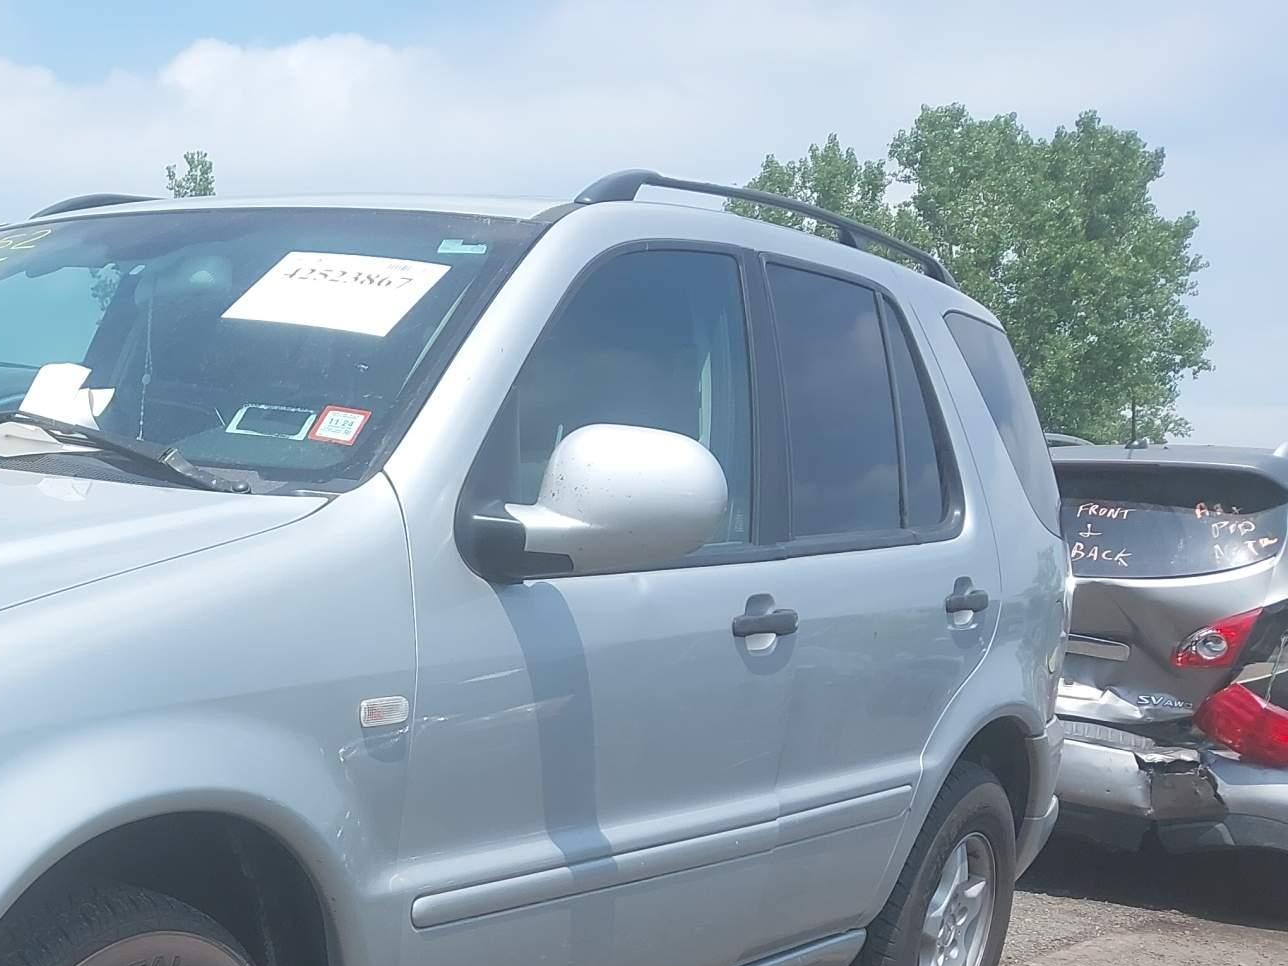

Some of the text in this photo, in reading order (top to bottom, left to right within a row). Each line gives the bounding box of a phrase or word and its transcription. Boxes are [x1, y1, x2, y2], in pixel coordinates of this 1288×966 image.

[282, 265, 415, 290] 42523867
[1076, 502, 1137, 520] FRONT
[1071, 541, 1133, 567] BACK
[1137, 695, 1164, 705] SV
